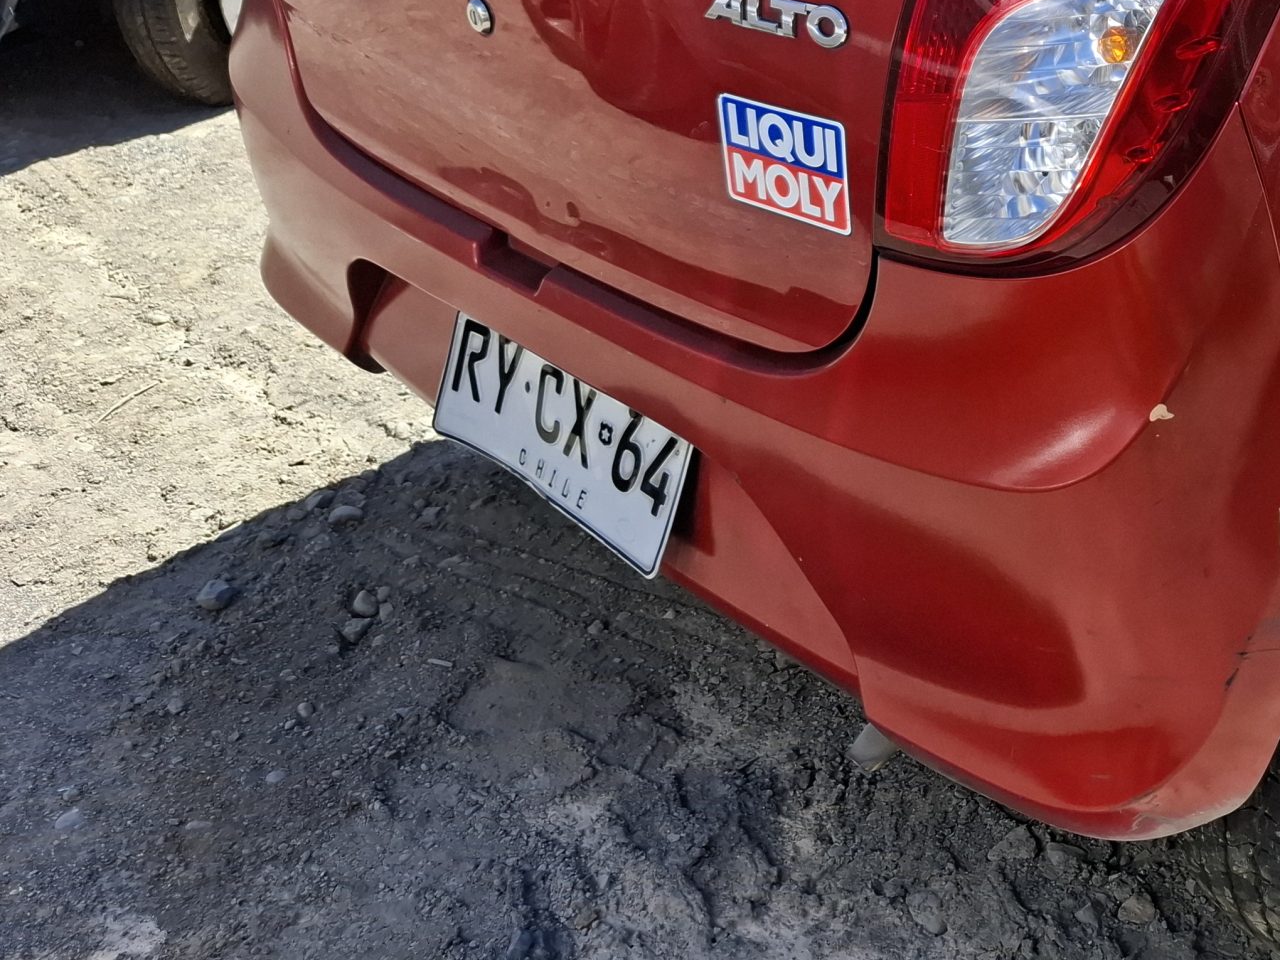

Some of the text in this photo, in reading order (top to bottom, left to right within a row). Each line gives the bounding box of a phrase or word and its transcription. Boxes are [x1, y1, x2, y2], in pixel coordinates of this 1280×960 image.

[727, 101, 838, 174] LIQUI
[732, 151, 843, 223] MOLY
[518, 447, 588, 510] CHILE
